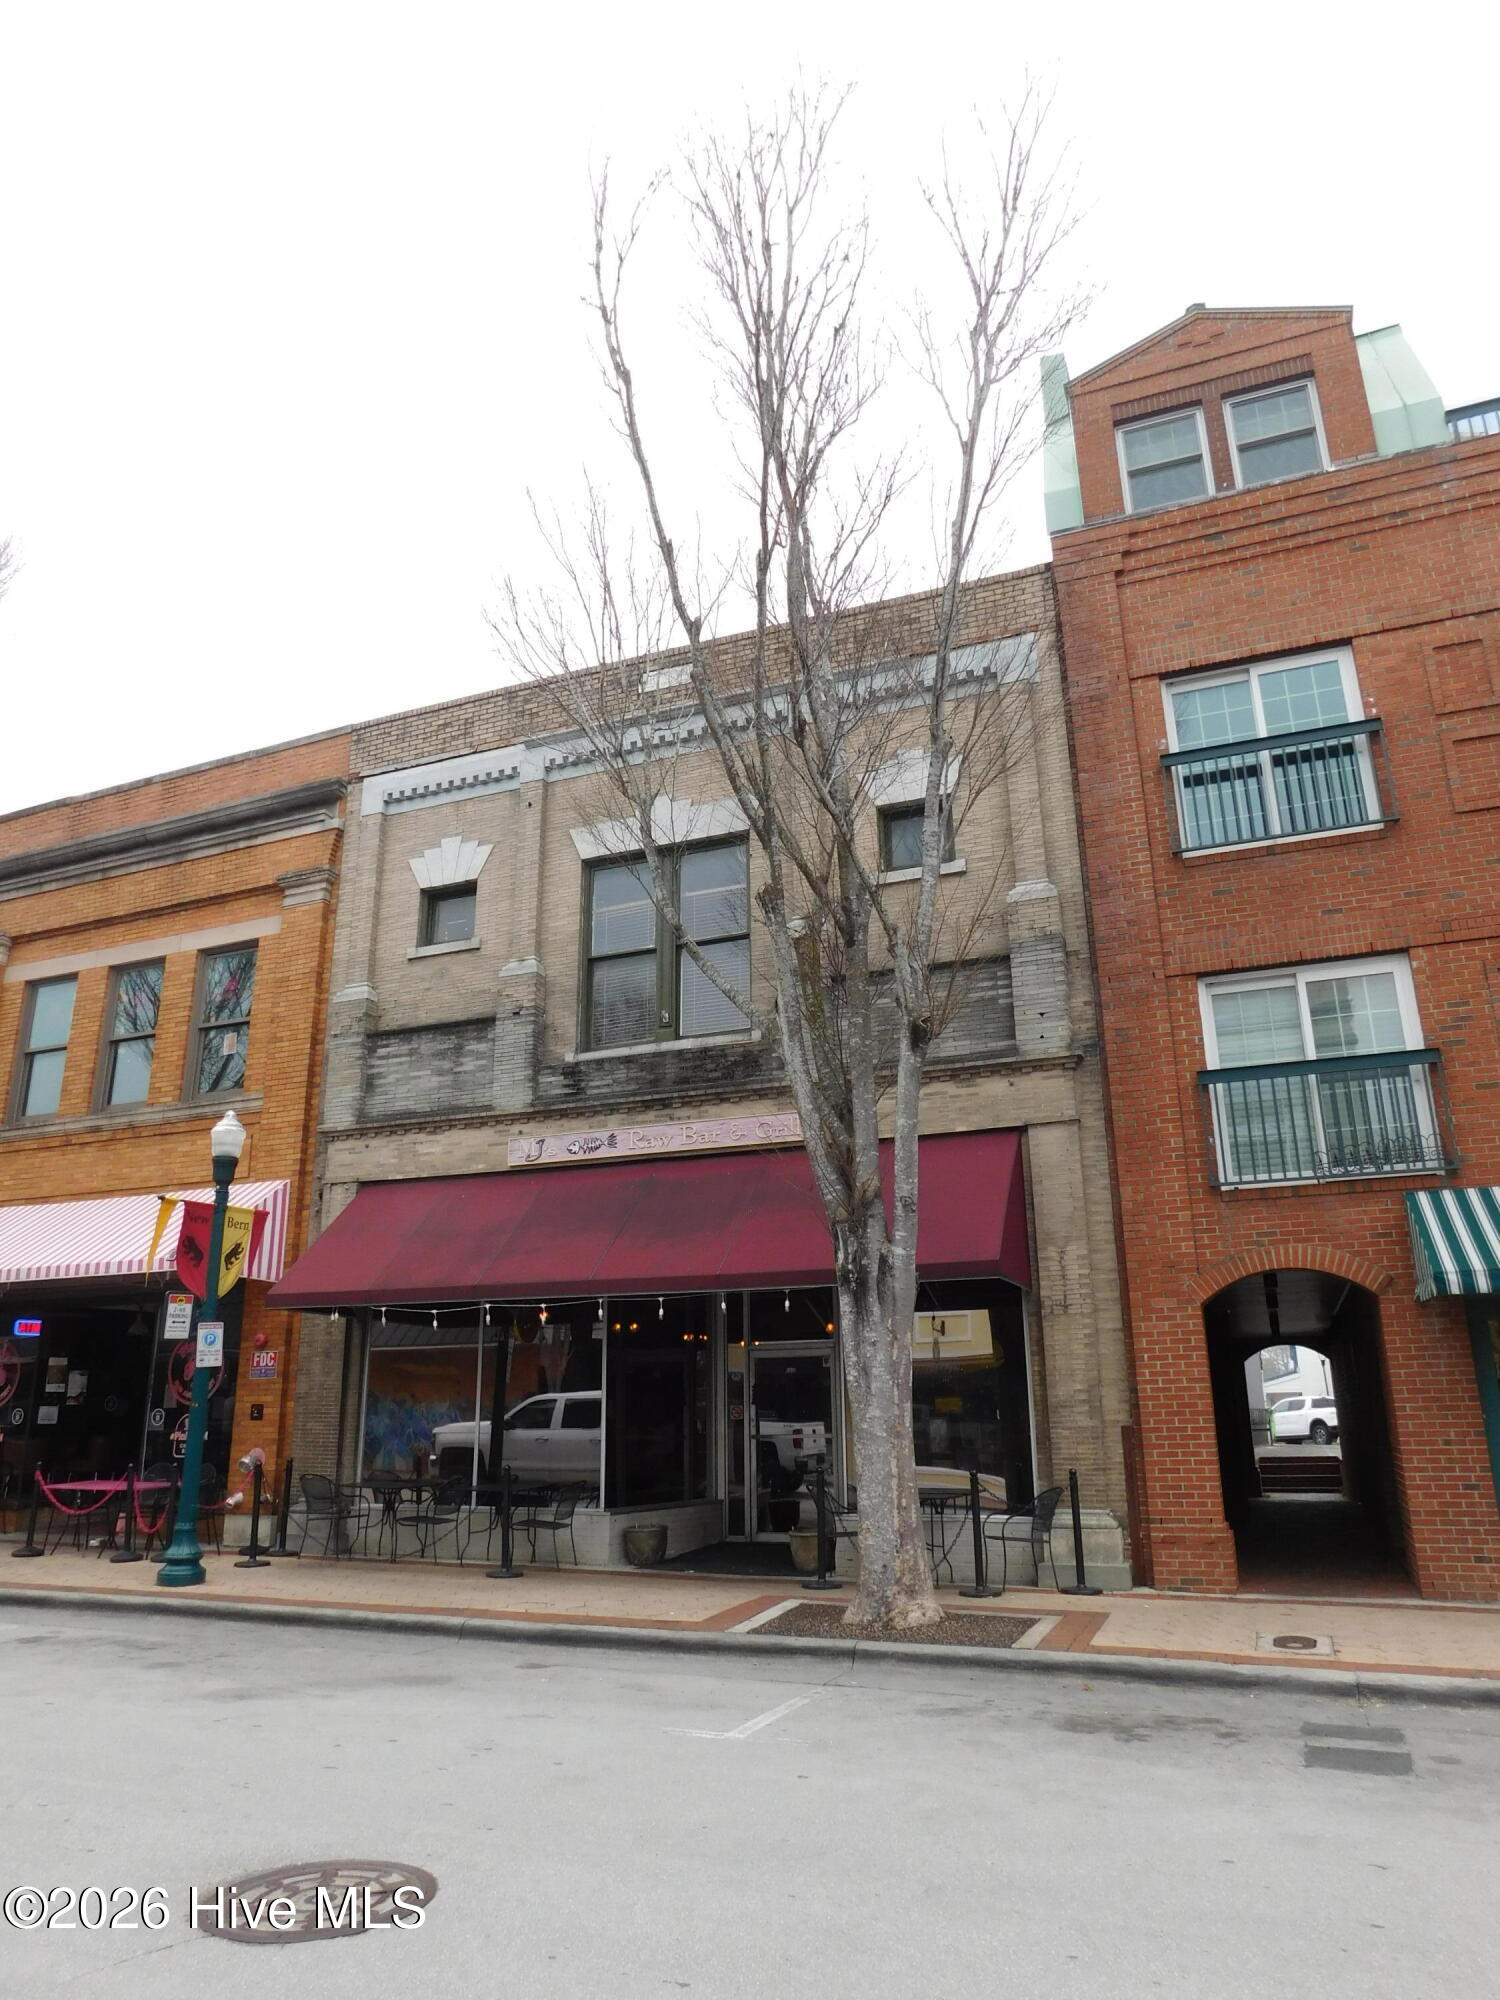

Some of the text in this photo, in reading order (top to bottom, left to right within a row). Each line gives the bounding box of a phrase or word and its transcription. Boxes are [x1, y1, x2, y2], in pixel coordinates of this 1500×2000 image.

[628, 1130, 673, 1150] Raw
[680, 1125, 721, 1146] Bar
[729, 1122, 747, 1141] &
[227, 1215, 250, 1231] Bern
[253, 1351, 276, 1367] FDC
